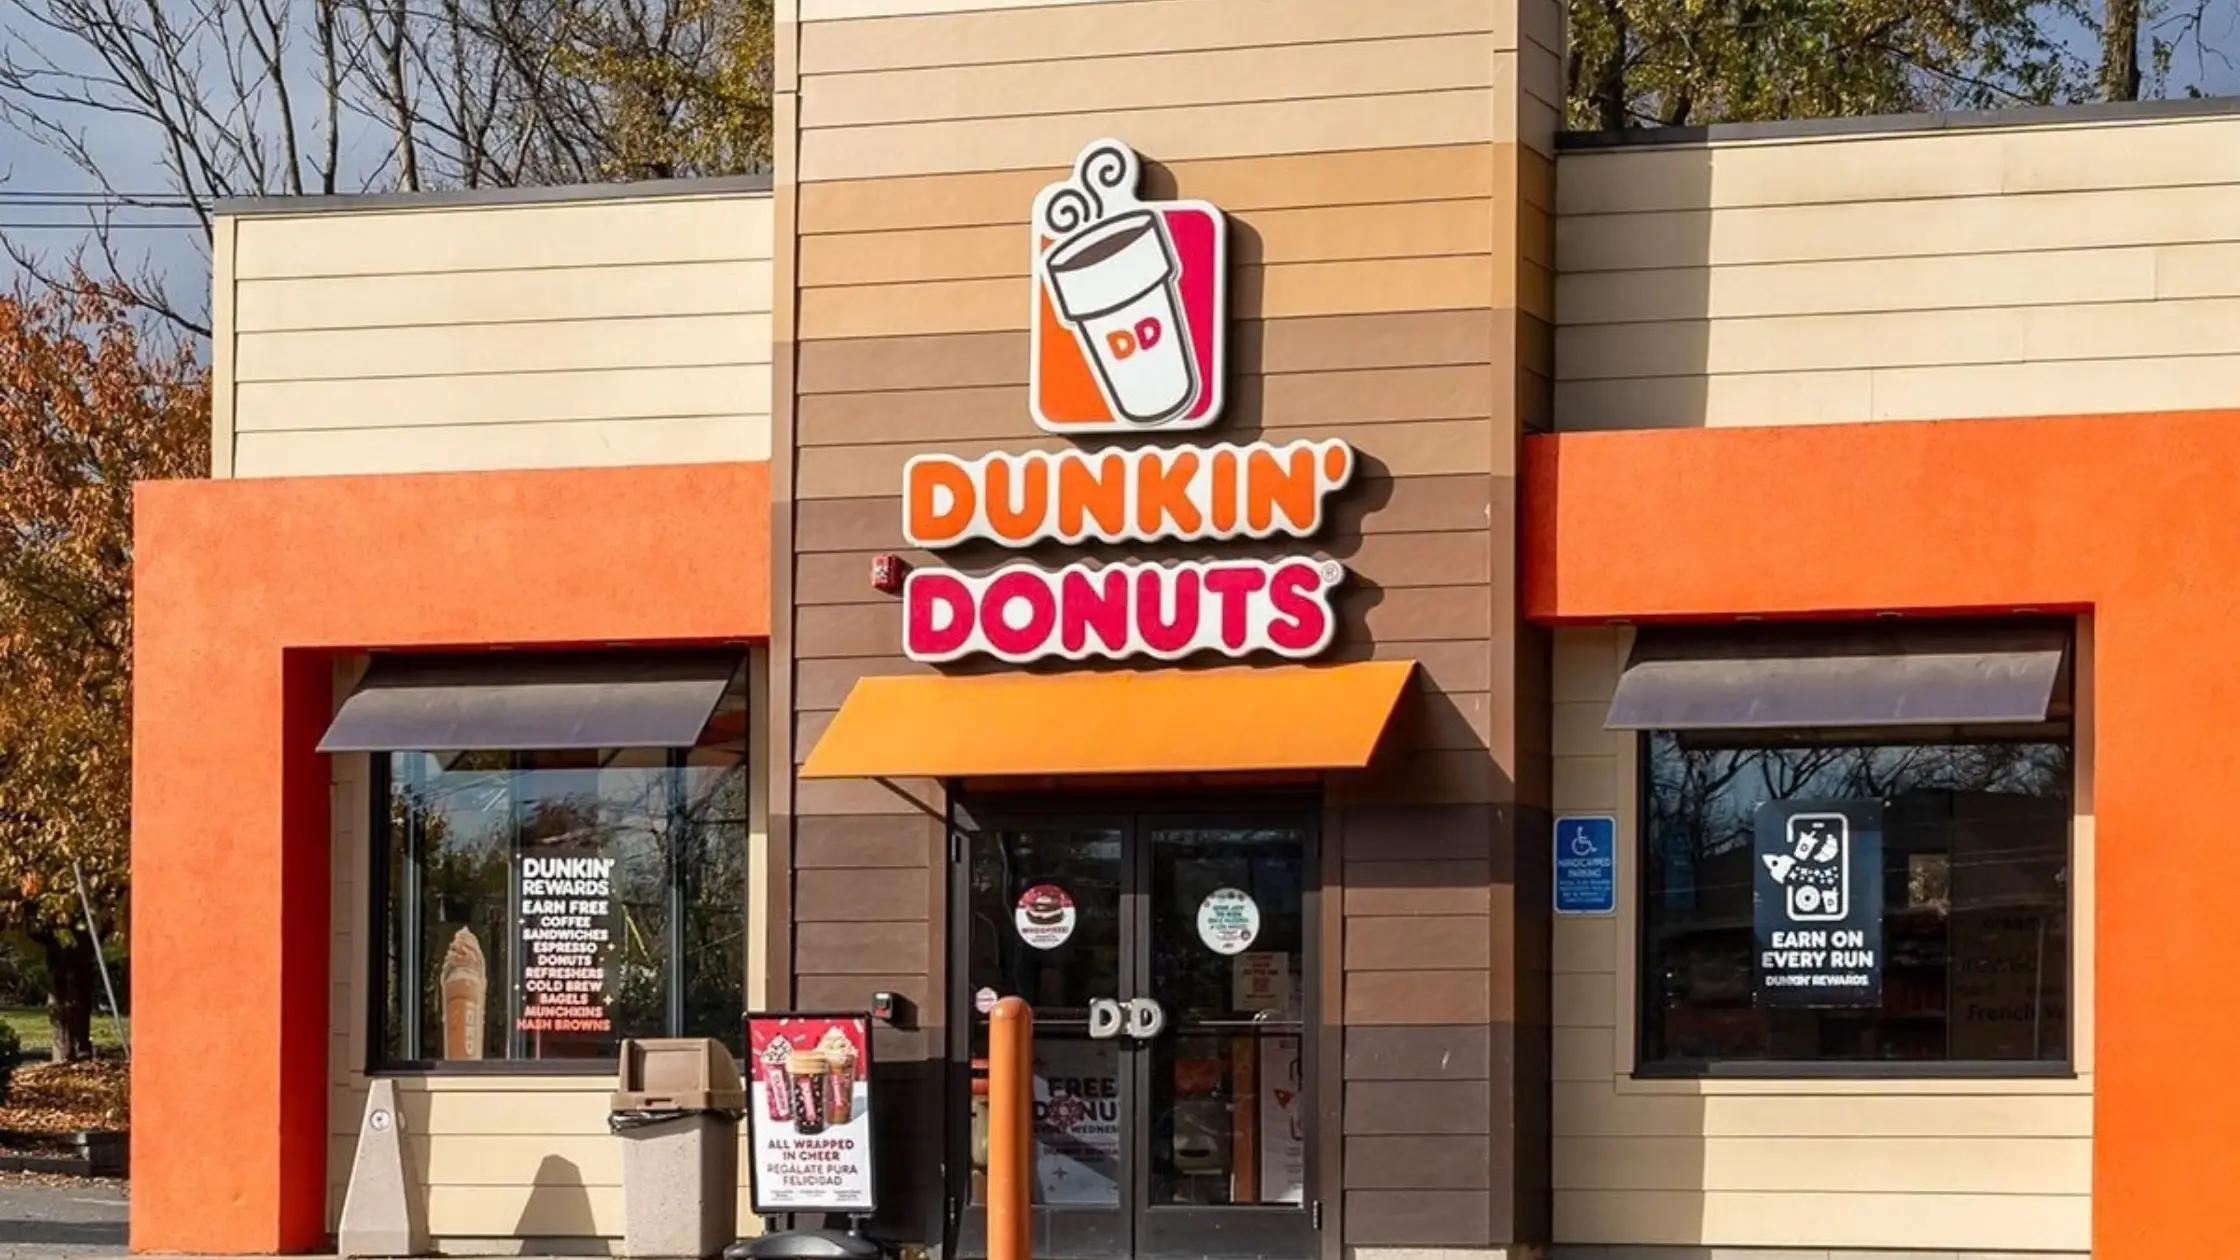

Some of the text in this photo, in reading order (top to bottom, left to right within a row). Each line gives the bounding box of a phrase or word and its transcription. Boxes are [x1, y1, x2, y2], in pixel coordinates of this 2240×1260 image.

[1106, 316, 1161, 361] DD
[908, 444, 1347, 541] DUNKIN'
[522, 858, 615, 878] DUNKIN'
[1567, 868, 1602, 878] PARKING
[522, 880, 609, 895] REWARDS
[522, 900, 609, 914] EARN FREE
[540, 916, 591, 927] COFFEE
[522, 929, 608, 940] SANDWICHES
[1771, 930, 1863, 948] EARN ON
[533, 942, 598, 953] ESPRESSO
[537, 955, 592, 966] DONUTS
[1761, 950, 1874, 968] EVERY RUN
[525, 968, 604, 979] REFRESHERS
[526, 980, 603, 991] COLD BREW
[1811, 974, 1869, 986] REWARDS
[539, 993, 589, 1004] BAGELS
[524, 1006, 603, 1018] MUNCHKINS
[516, 1019, 611, 1031] HASH BROWNS
[1048, 1077, 1117, 1098] FREE
[768, 1139, 854, 1149] ALL WRAPPED
[783, 1151, 840, 1161] IN CHEER
[826, 1164, 858, 1174] PURA
[782, 1176, 842, 1186] FELICIDAD
